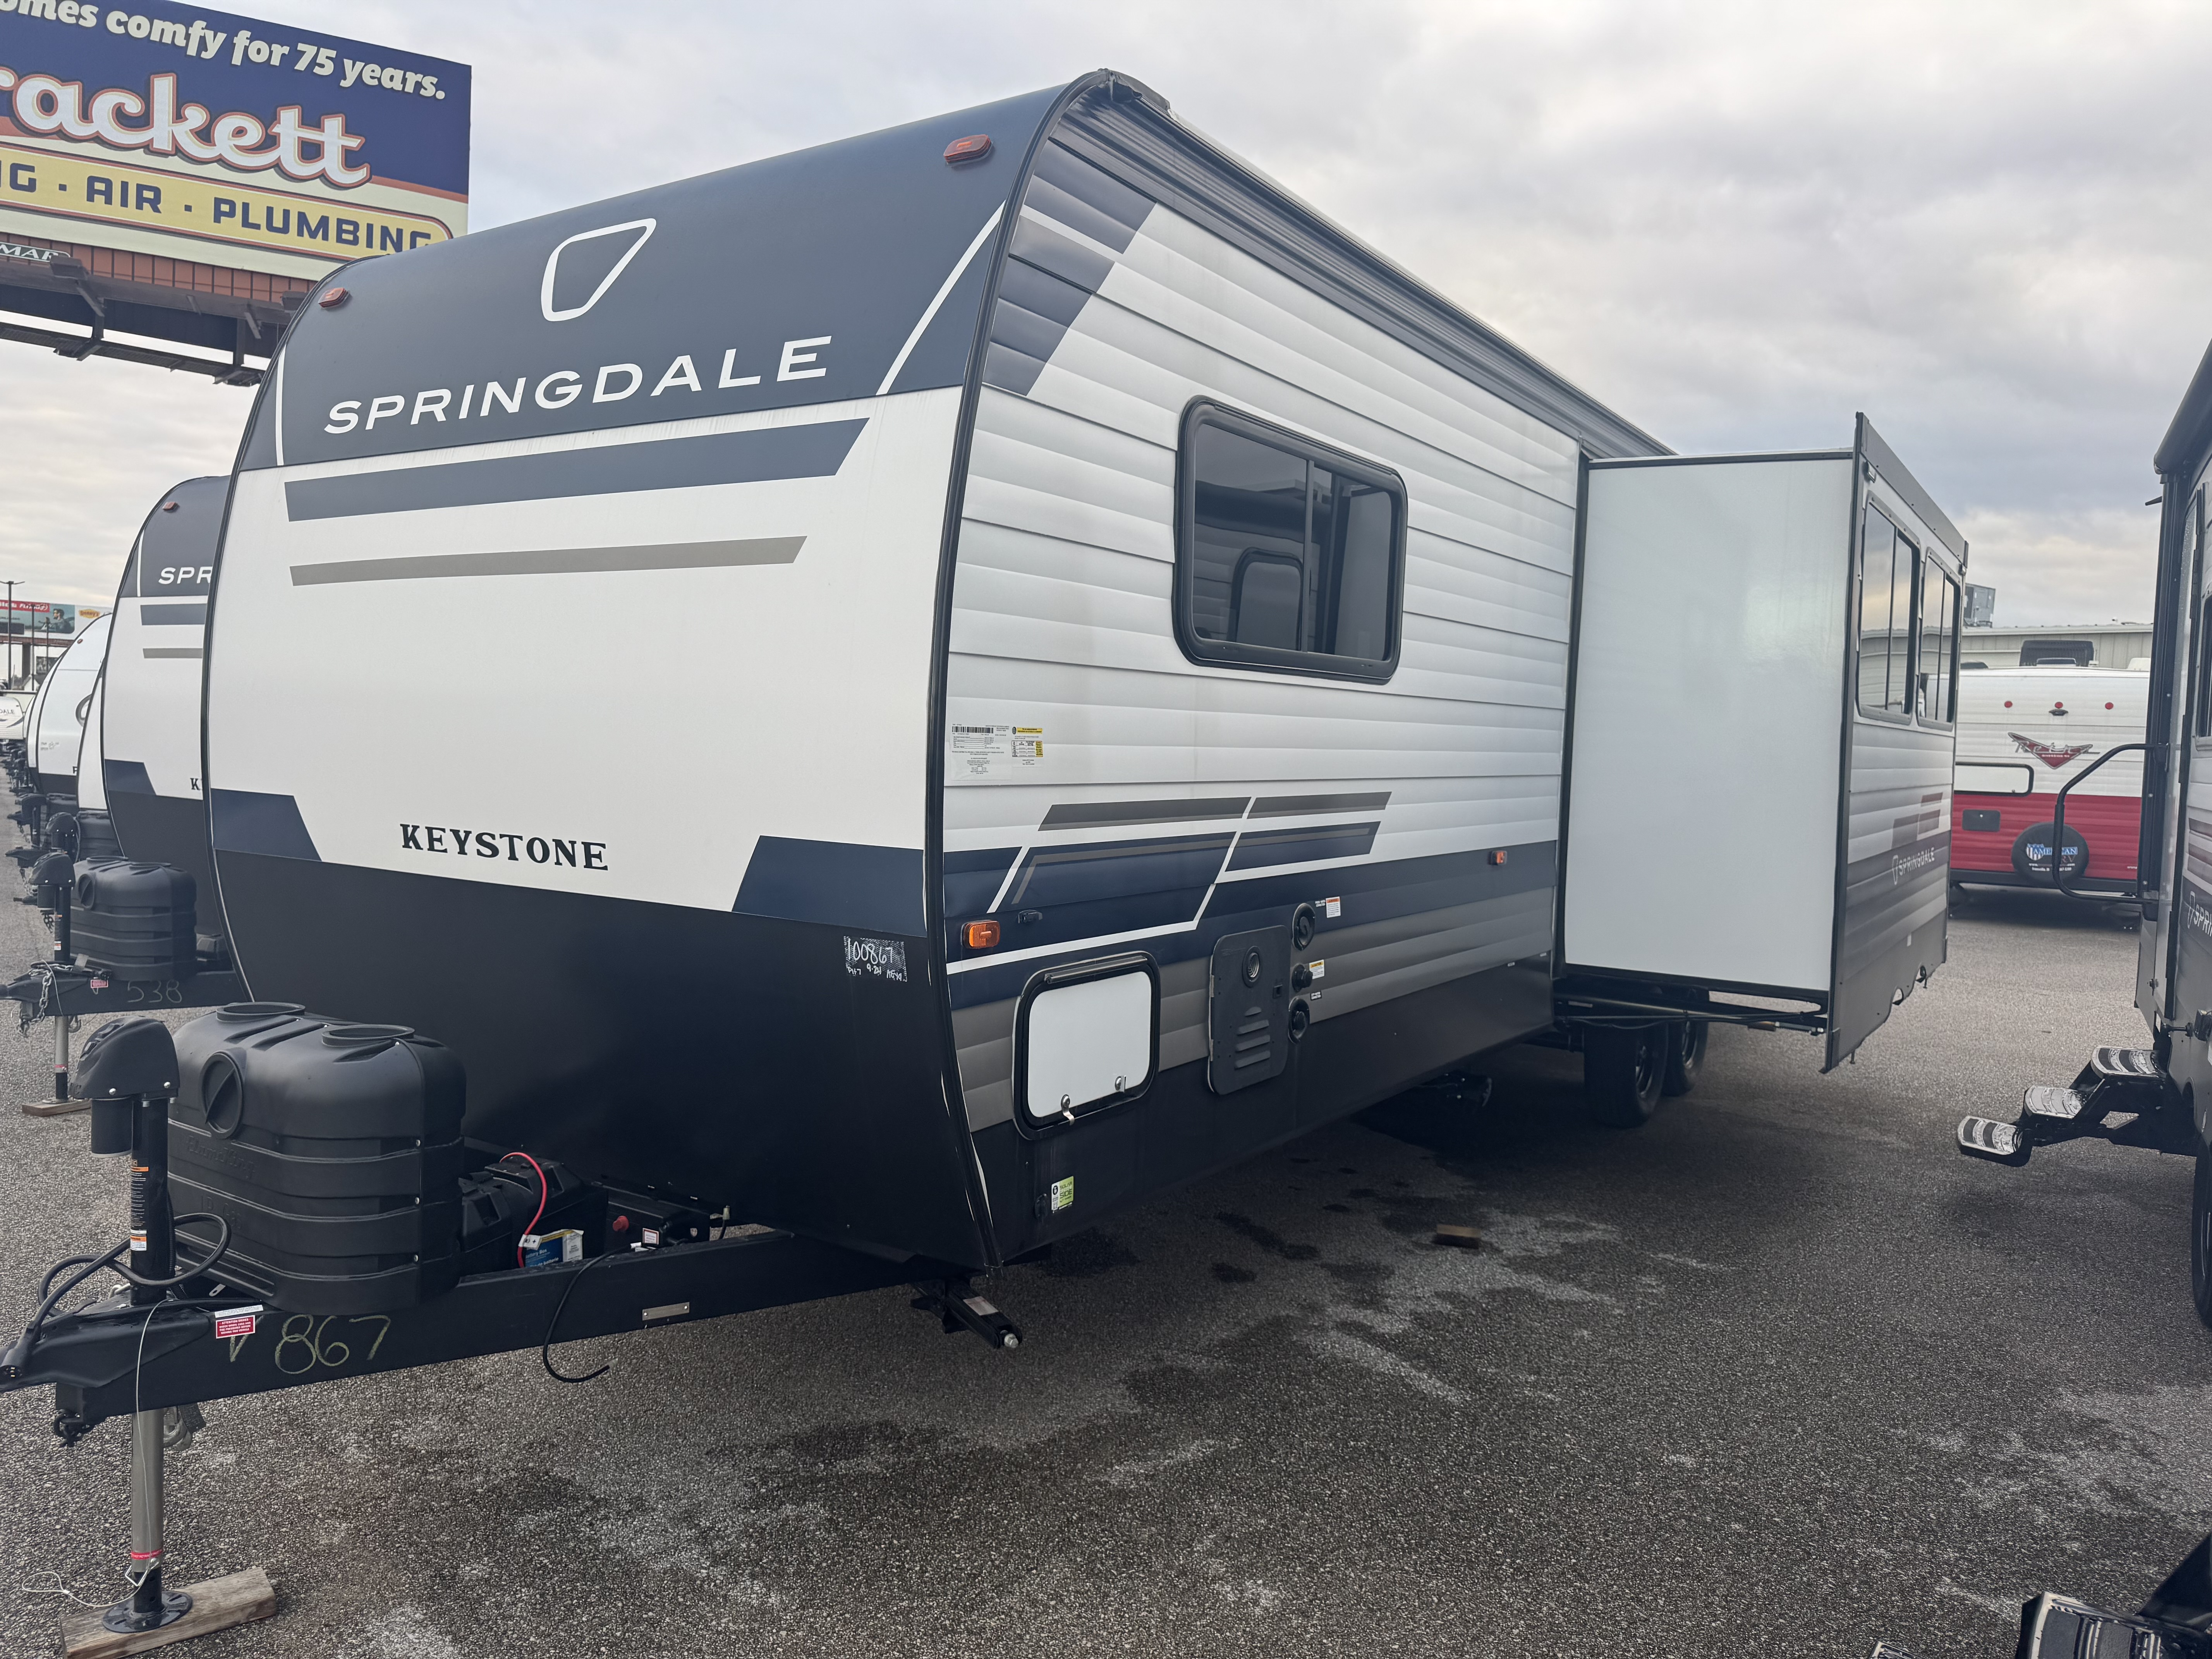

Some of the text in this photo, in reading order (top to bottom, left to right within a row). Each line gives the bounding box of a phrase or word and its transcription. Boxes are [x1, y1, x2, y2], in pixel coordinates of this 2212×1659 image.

[106, 11, 227, 59] comfy
[232, 30, 290, 66] for
[294, 43, 337, 76] 75
[340, 58, 445, 100] years.
[86, 175, 162, 214] AIR
[324, 335, 832, 434] SPRINGDALE
[158, 566, 213, 584] SPR
[400, 824, 608, 871] KEYSTONE
[1899, 847, 1935, 876] SPRINGDALE
[127, 979, 182, 1003] 538
[275, 1314, 391, 1374] 867
